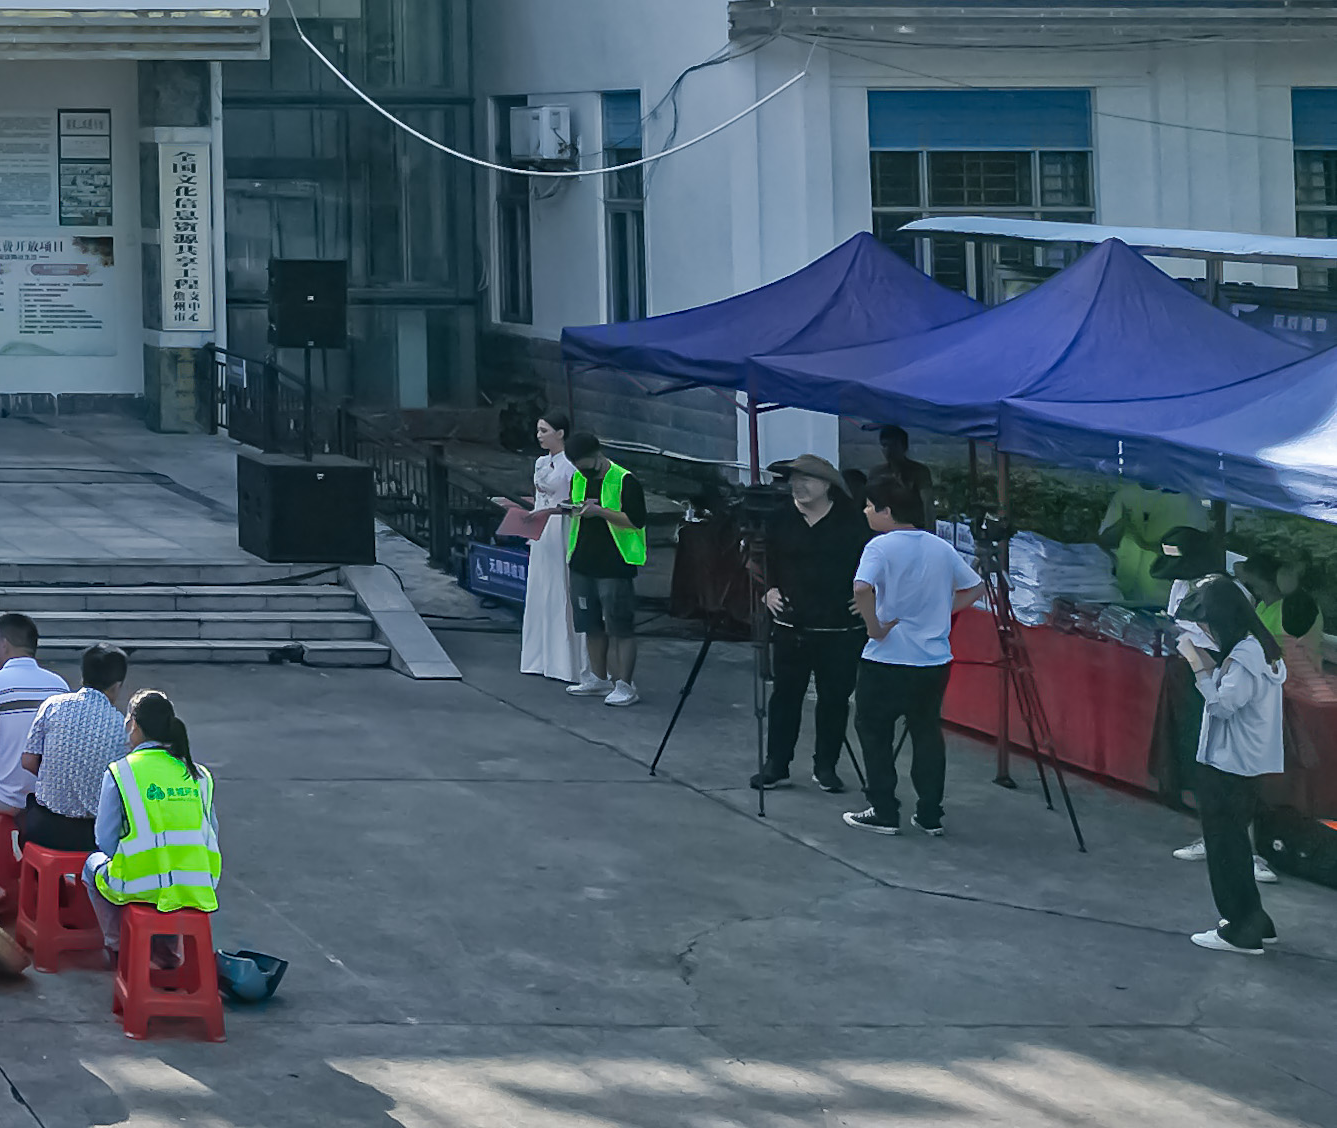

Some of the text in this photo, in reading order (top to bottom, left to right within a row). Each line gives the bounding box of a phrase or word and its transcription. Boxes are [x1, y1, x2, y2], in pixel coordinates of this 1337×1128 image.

[172, 151, 199, 290] 全国文化信息资源共享工程
